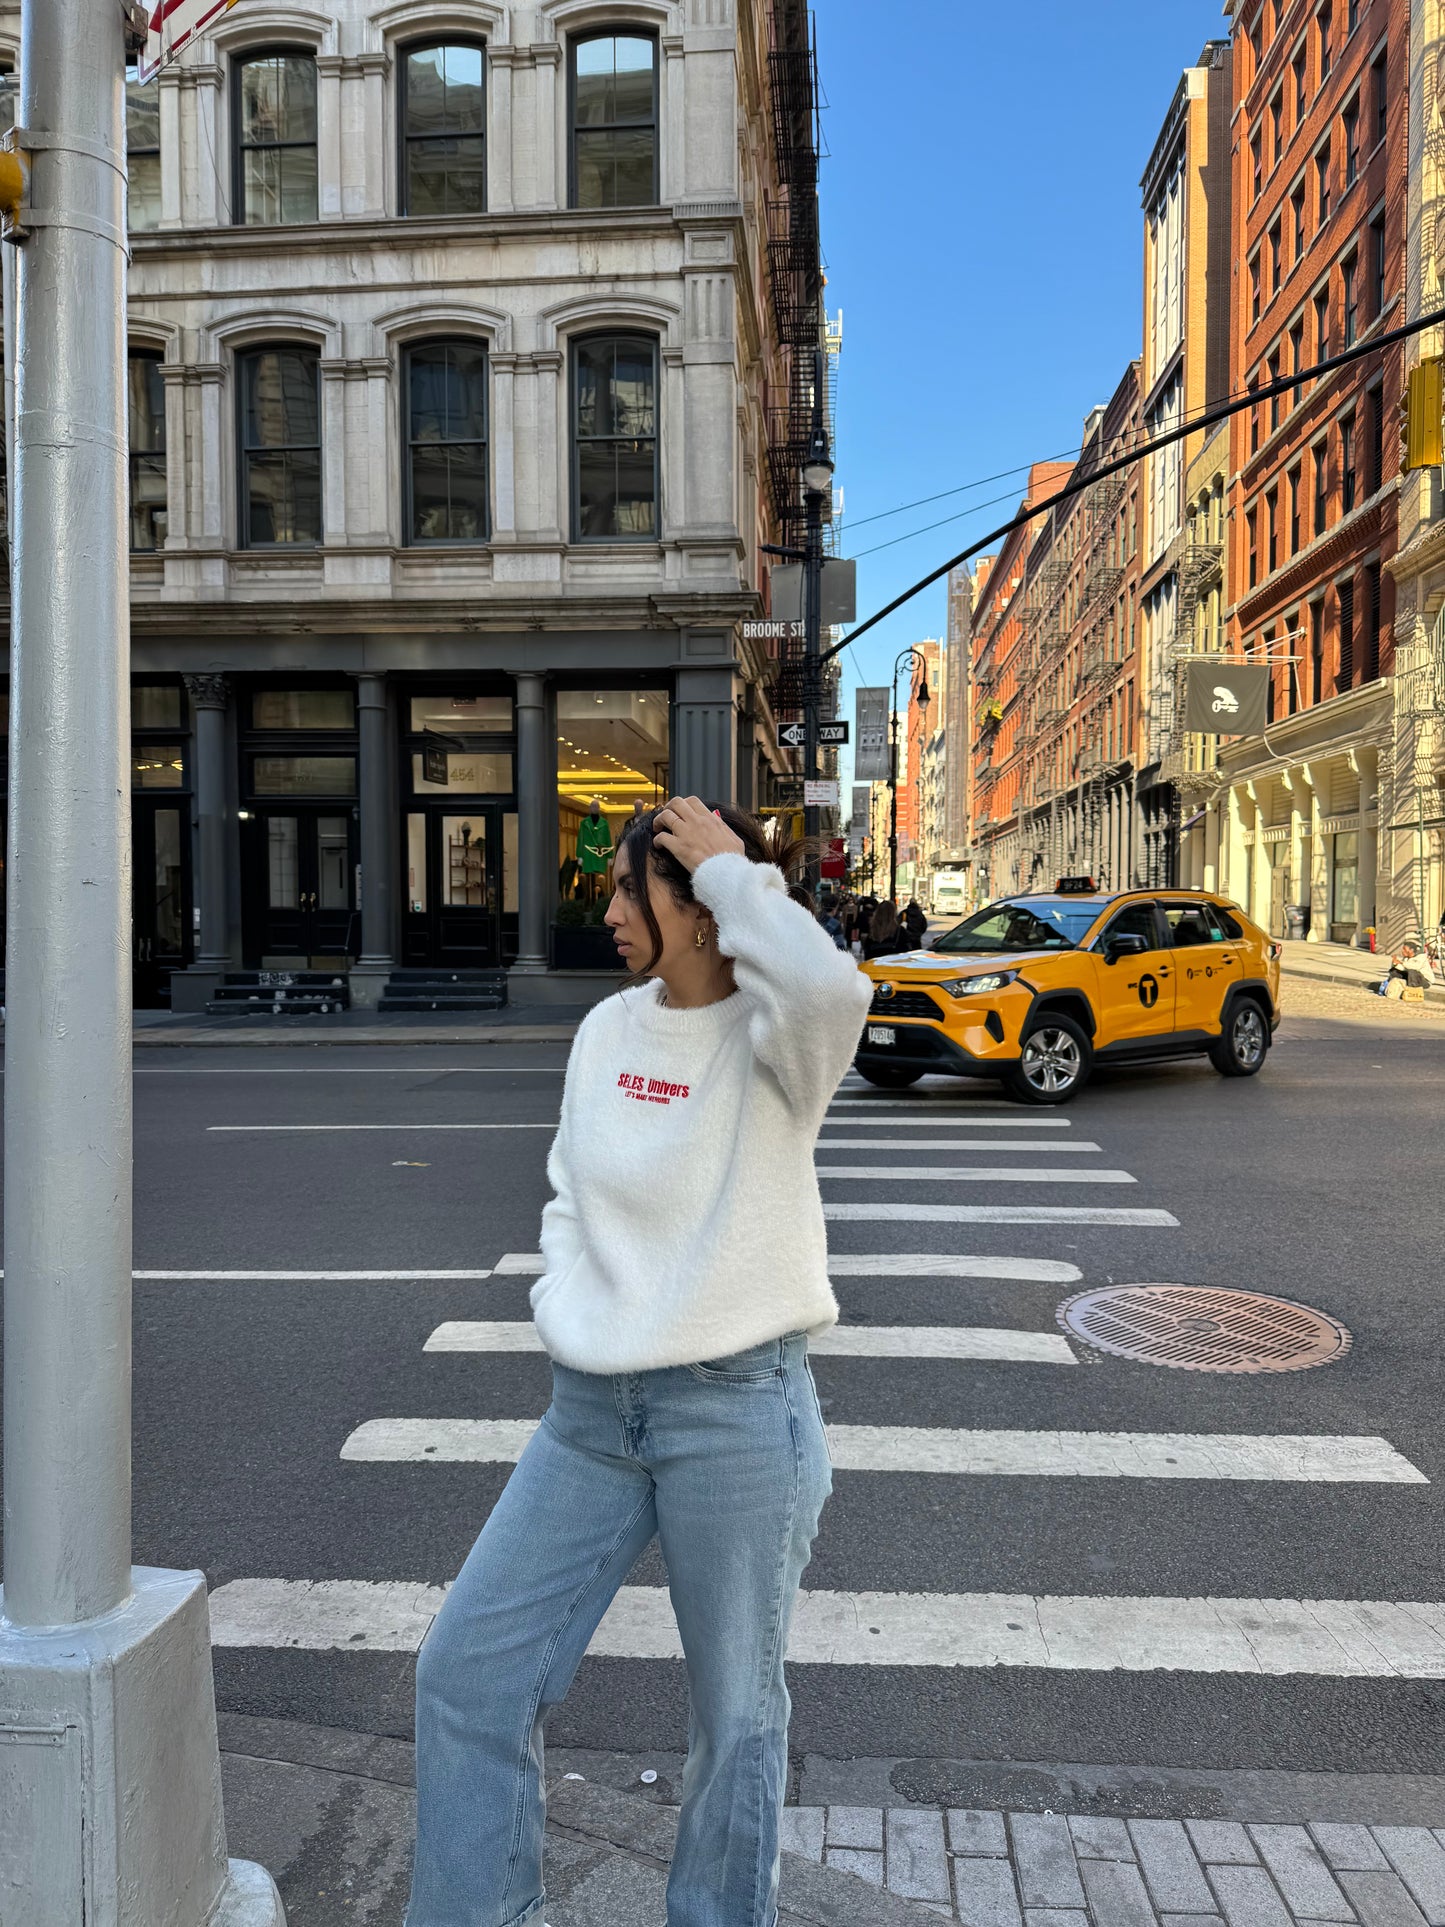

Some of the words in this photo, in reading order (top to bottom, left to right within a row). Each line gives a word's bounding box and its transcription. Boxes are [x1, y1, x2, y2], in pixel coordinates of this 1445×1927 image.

[743, 622, 786, 638] BROOME
[788, 729, 806, 740] ONE
[819, 728, 840, 738] WAY
[450, 768, 474, 782] 454
[617, 1073, 645, 1091] SELES
